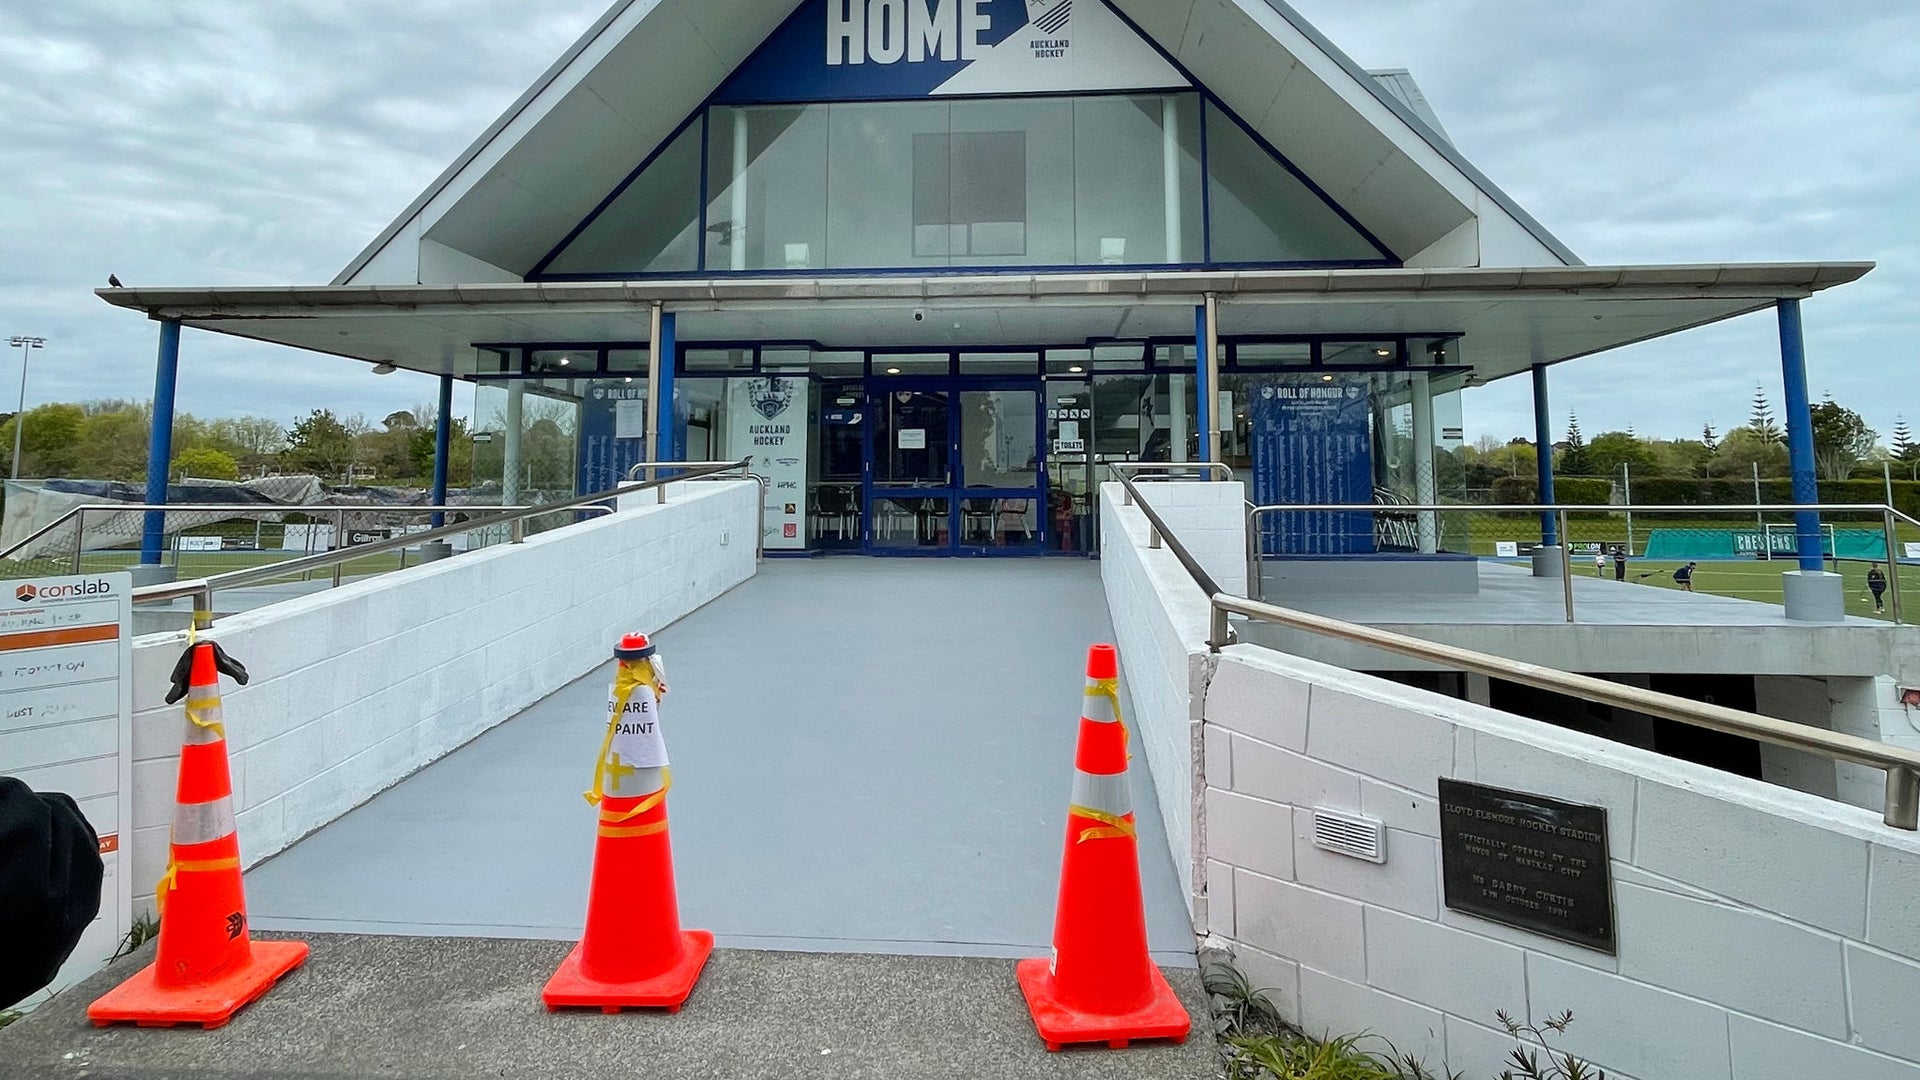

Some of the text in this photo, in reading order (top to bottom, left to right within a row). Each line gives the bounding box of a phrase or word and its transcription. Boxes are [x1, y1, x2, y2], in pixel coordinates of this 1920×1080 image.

[827, 0, 993, 65] HOME
[1030, 39, 1070, 49] AUCKLAND
[1035, 49, 1065, 58] HOCKEY
[607, 388, 626, 399] ROLL
[627, 388, 637, 399] OF
[1277, 387, 1343, 399] ROLL OF HONOUR
[749, 425, 791, 434] AUCKLAND
[754, 436, 784, 446] HOCKEY
[1061, 441, 1083, 449] TOILETS
[39, 579, 110, 598] conslab
[615, 722, 654, 734] PAINT
[1444, 803, 1602, 843] LLOYD ELSMORE HOCKEY STADIUM
[1459, 832, 1588, 868] OFFICIALLY OPENED BY THE
[1465, 844, 1582, 877] MAYOR OF MANUKAU CITY
[1491, 879, 1528, 895] BARRY
[1535, 890, 1575, 907] CURTIS
[1504, 895, 1540, 910] OCTOBER
